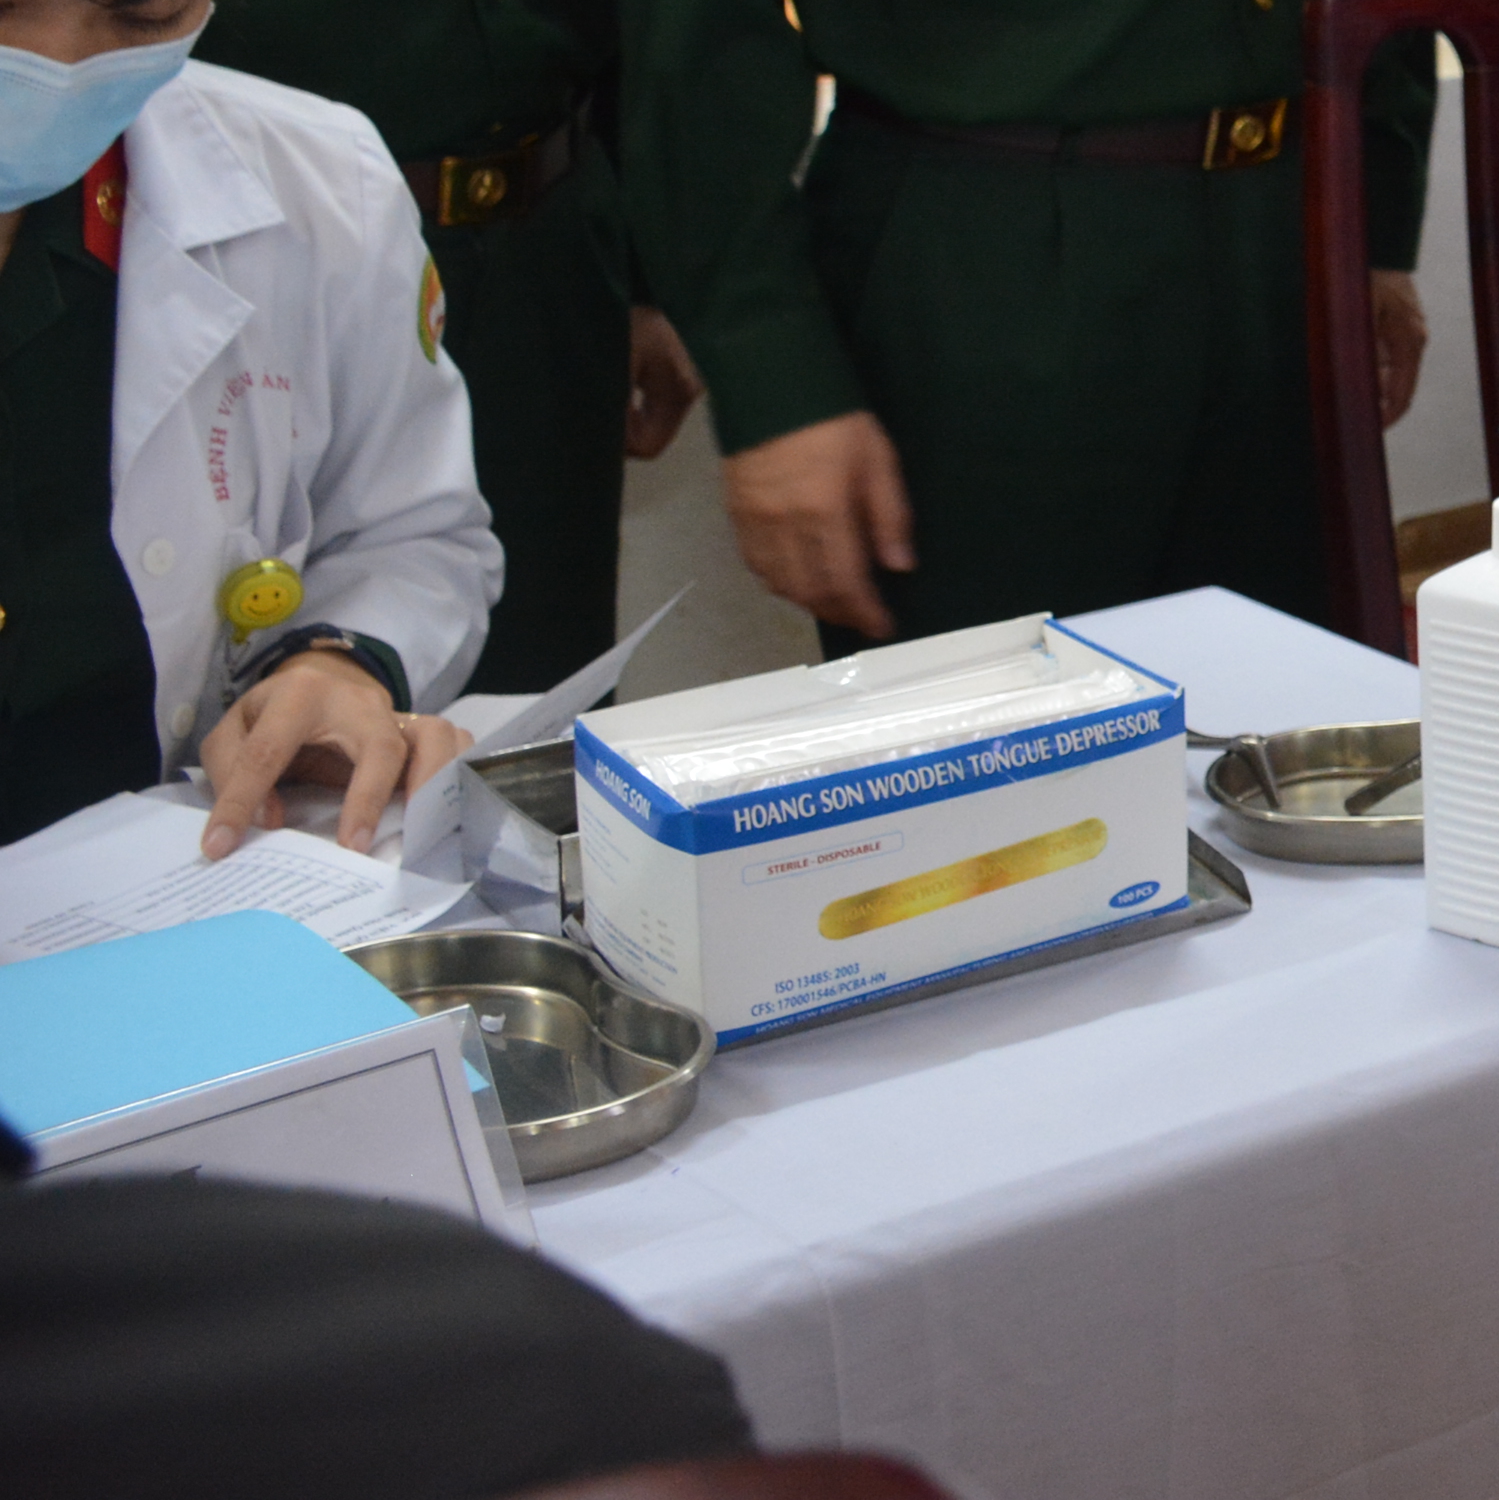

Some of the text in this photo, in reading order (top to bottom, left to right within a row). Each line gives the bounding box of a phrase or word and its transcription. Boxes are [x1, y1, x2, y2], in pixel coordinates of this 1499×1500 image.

[733, 709, 1162, 833] HOANG SON WOODEN TONGUE DEPRESSOR
[595, 758, 652, 821] HOANG SON
[767, 858, 809, 875] STERILE
[817, 841, 882, 865] DISPOSABLE
[775, 979, 794, 994] ISO
[834, 963, 860, 979] 2003
[751, 1002, 776, 1017] CFS:
